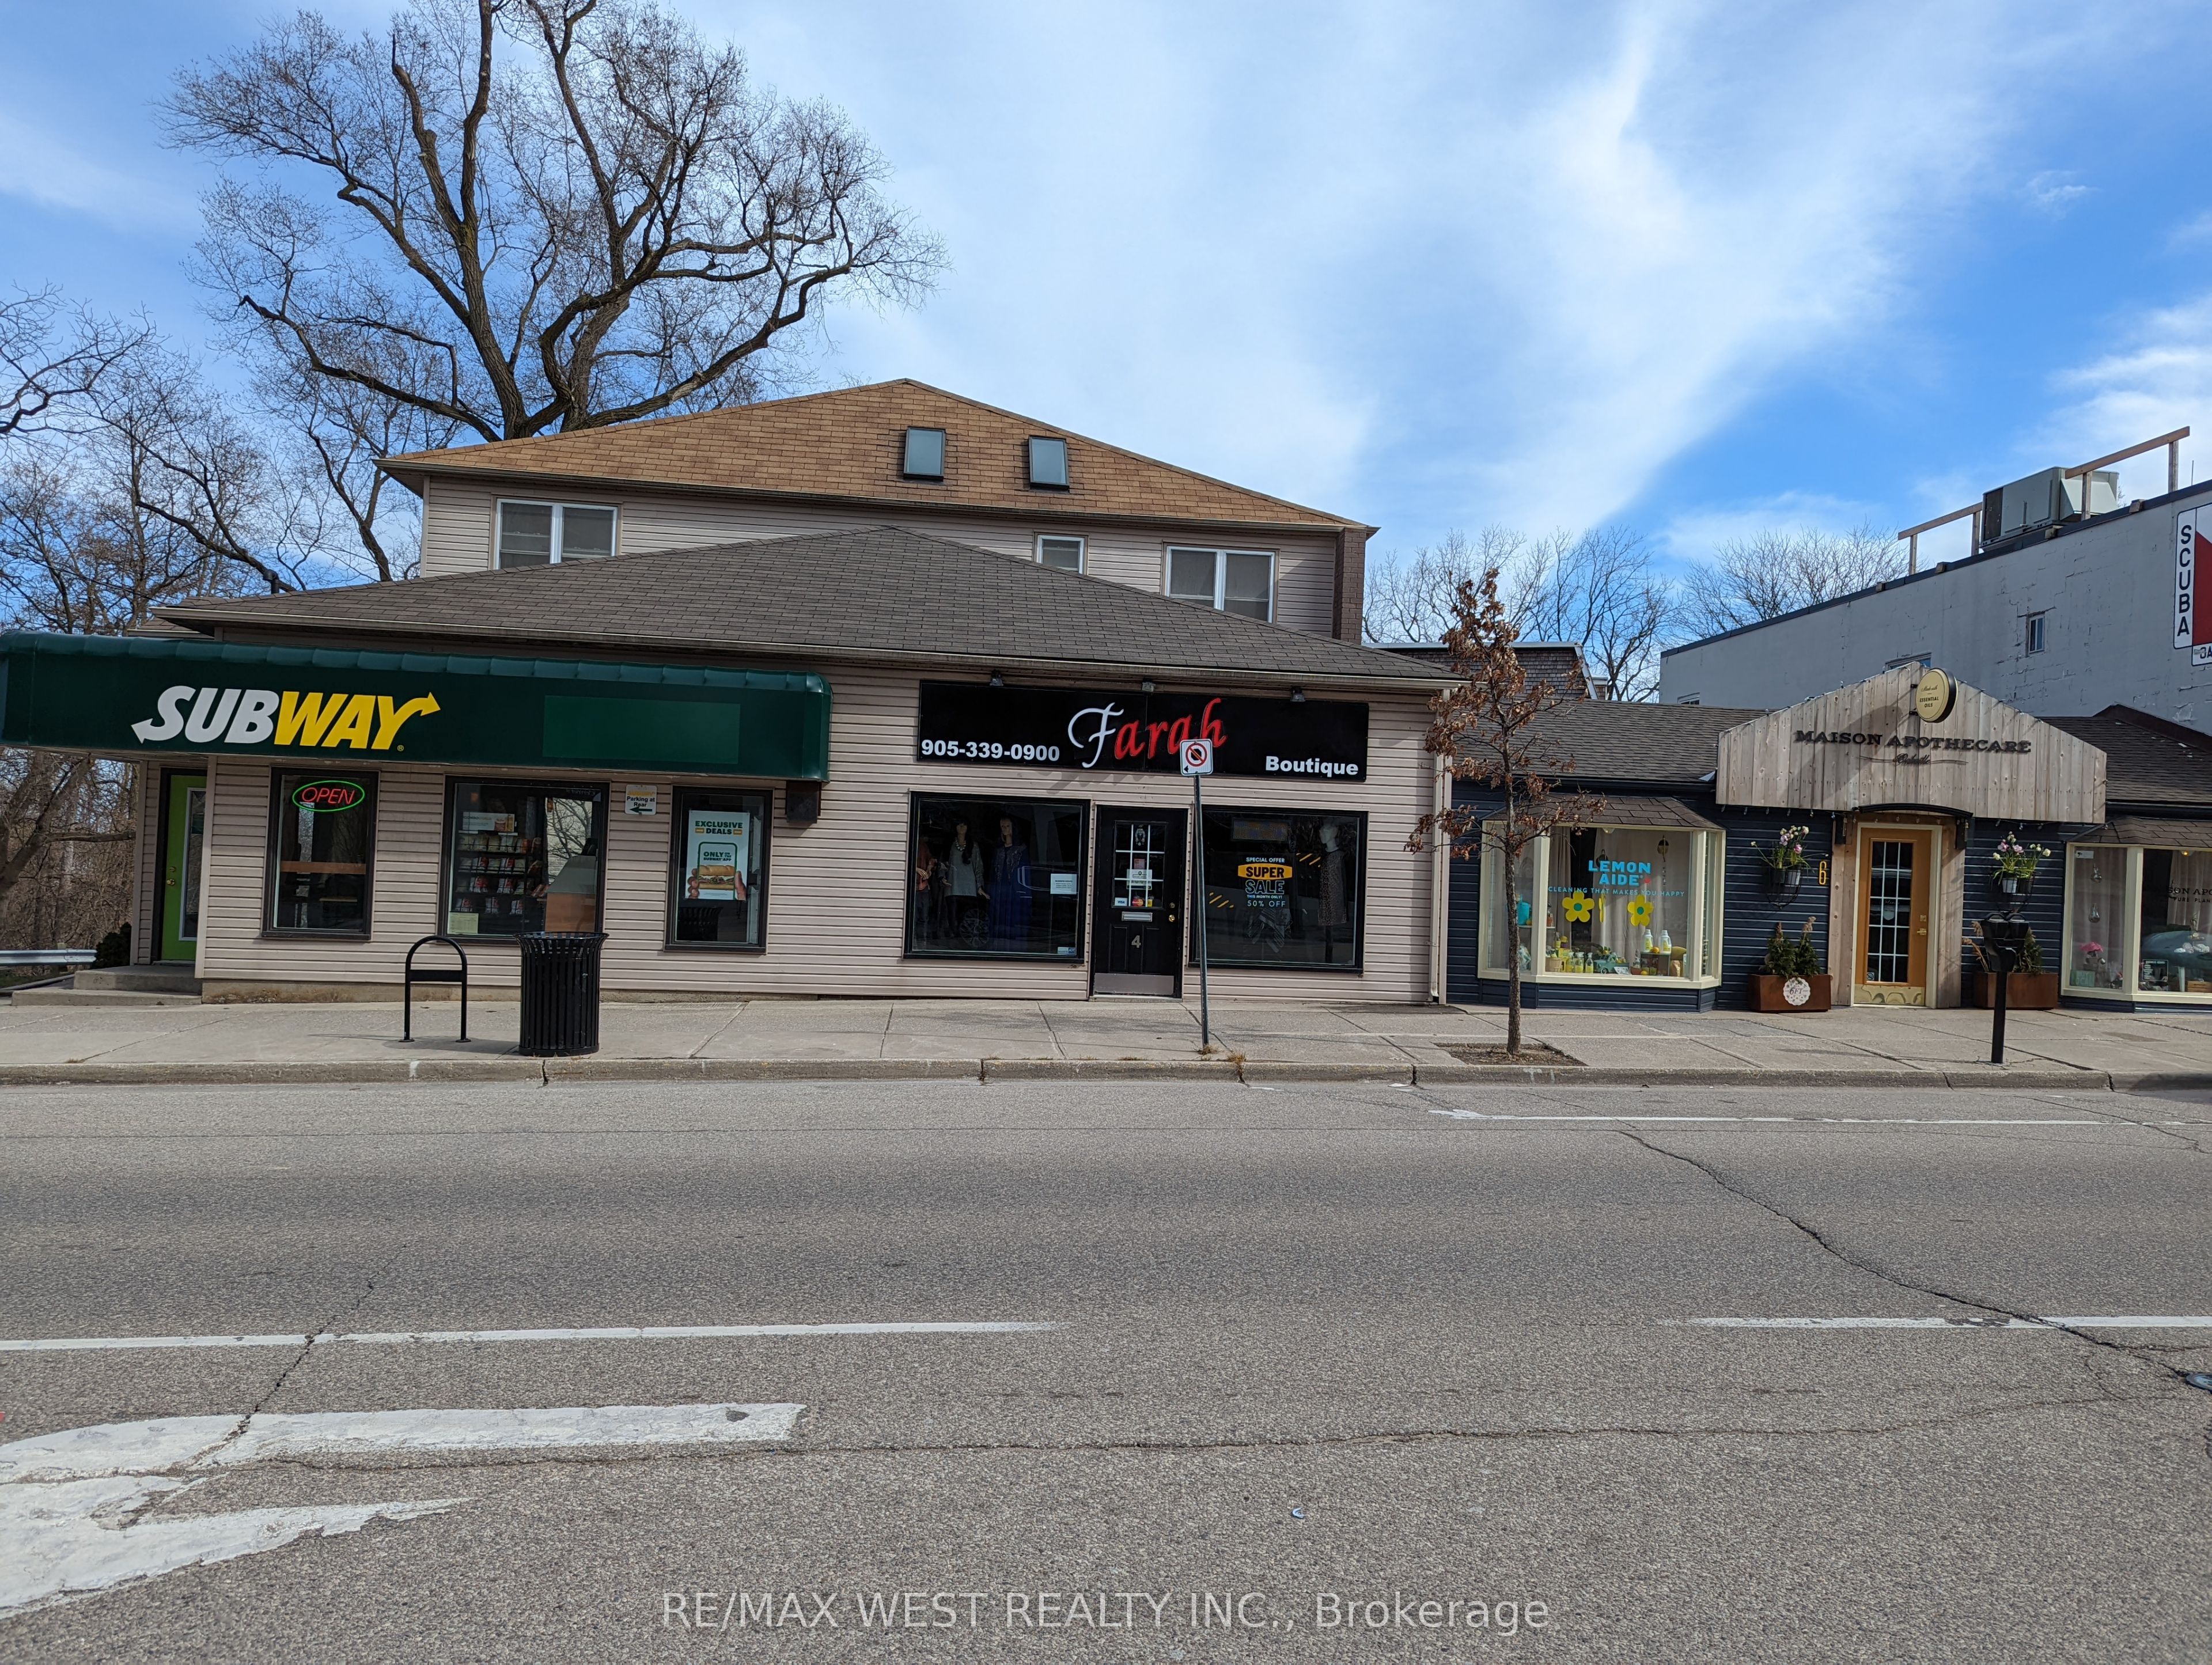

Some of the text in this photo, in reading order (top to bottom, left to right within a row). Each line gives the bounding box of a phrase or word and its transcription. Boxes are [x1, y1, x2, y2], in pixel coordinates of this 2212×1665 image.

[2176, 525, 2192, 636] SCUBA
[131, 685, 441, 750] SUBWAY
[1067, 697, 1228, 768] Farah
[1795, 730, 2032, 753] MAISON APOTHECARE
[921, 739, 1060, 761] 905-339-0900
[1265, 756, 1359, 777] Boutique
[302, 787, 355, 805] OPEN
[1245, 866, 1285, 878] SUPER
[1588, 860, 1652, 874] LEMON
[1819, 861, 1827, 885] 6
[1245, 879, 1285, 894] SALE
[1599, 873, 1640, 886] AIDE
[1131, 935, 1141, 949] 4
